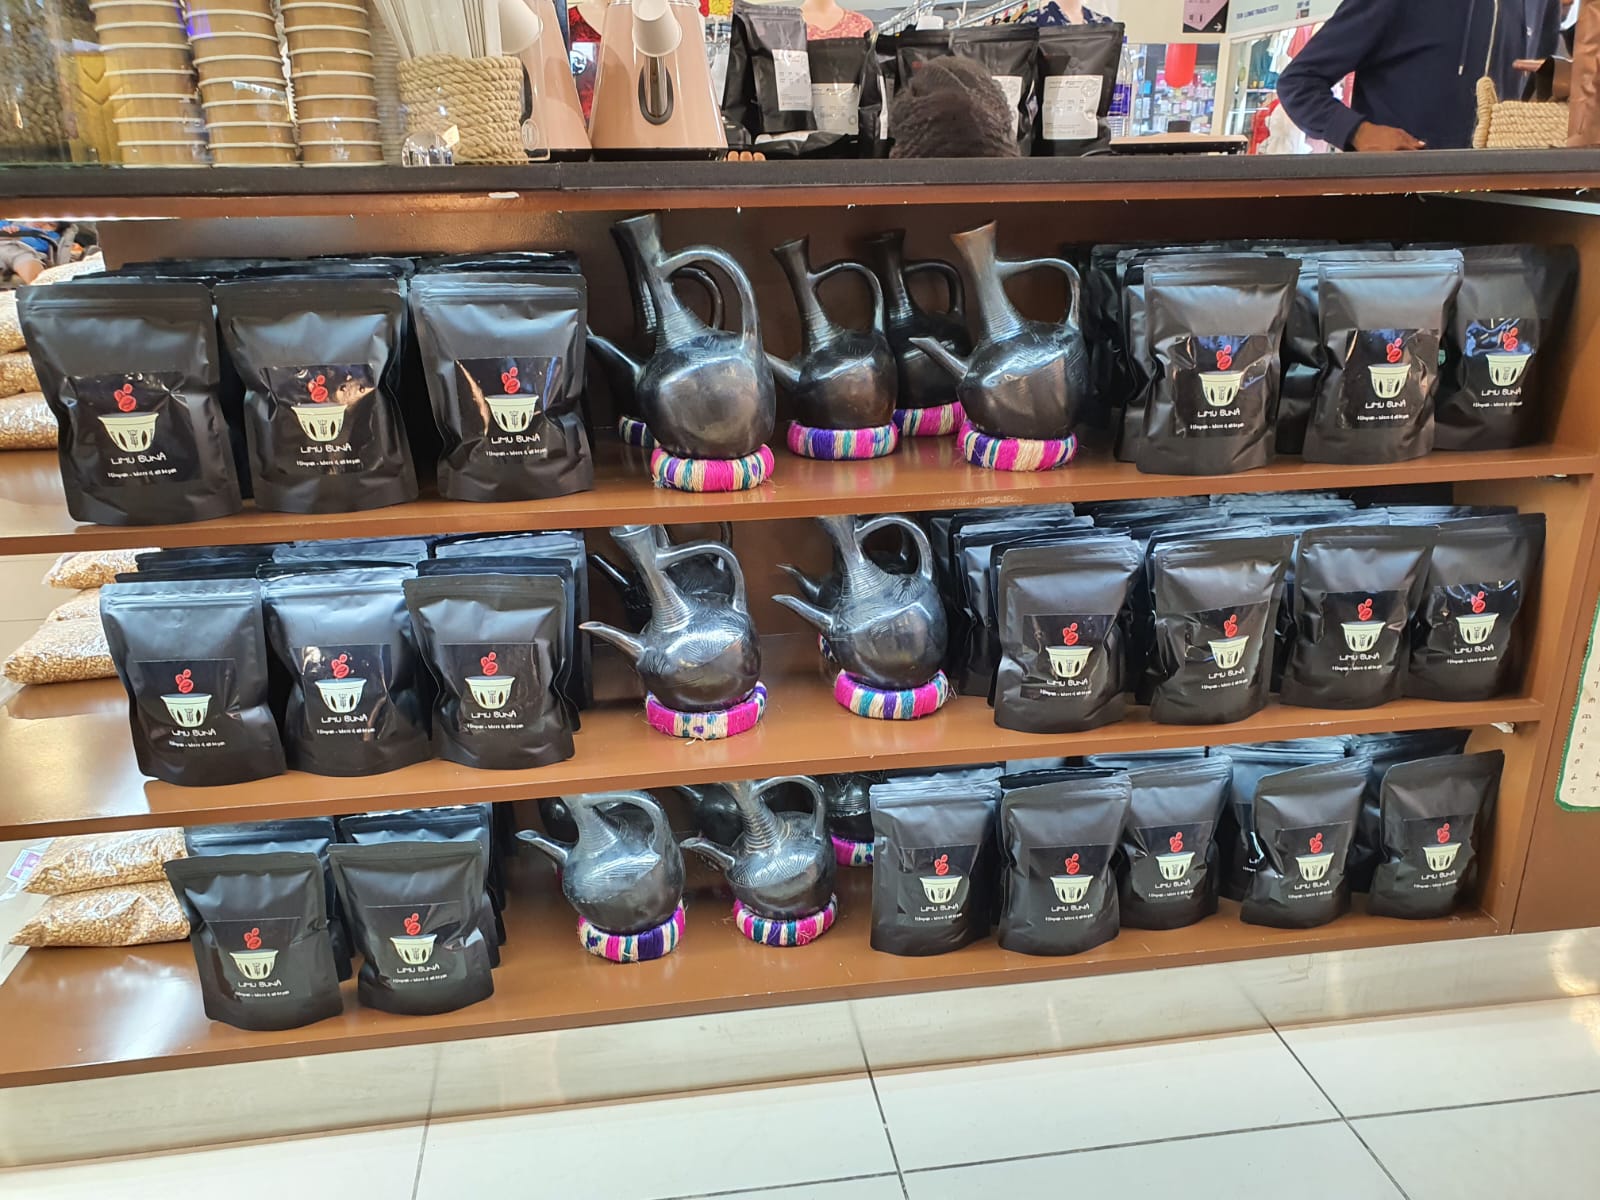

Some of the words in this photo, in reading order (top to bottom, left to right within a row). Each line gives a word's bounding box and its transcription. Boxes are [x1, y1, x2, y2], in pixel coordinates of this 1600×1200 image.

[1502, 388, 1521, 396] BUNA
[1387, 399, 1406, 408] BUNA
[1220, 408, 1240, 416] BUNA
[516, 433, 540, 442] BUNA
[326, 443, 351, 452] BUNA
[138, 452, 167, 462] BUNA
[1360, 652, 1380, 660] BUNA
[1227, 667, 1244, 676] BUNA
[1068, 679, 1088, 687] BUNA
[344, 713, 368, 722] BUNA
[493, 710, 516, 718] BUNA
[193, 728, 217, 736] BUNA
